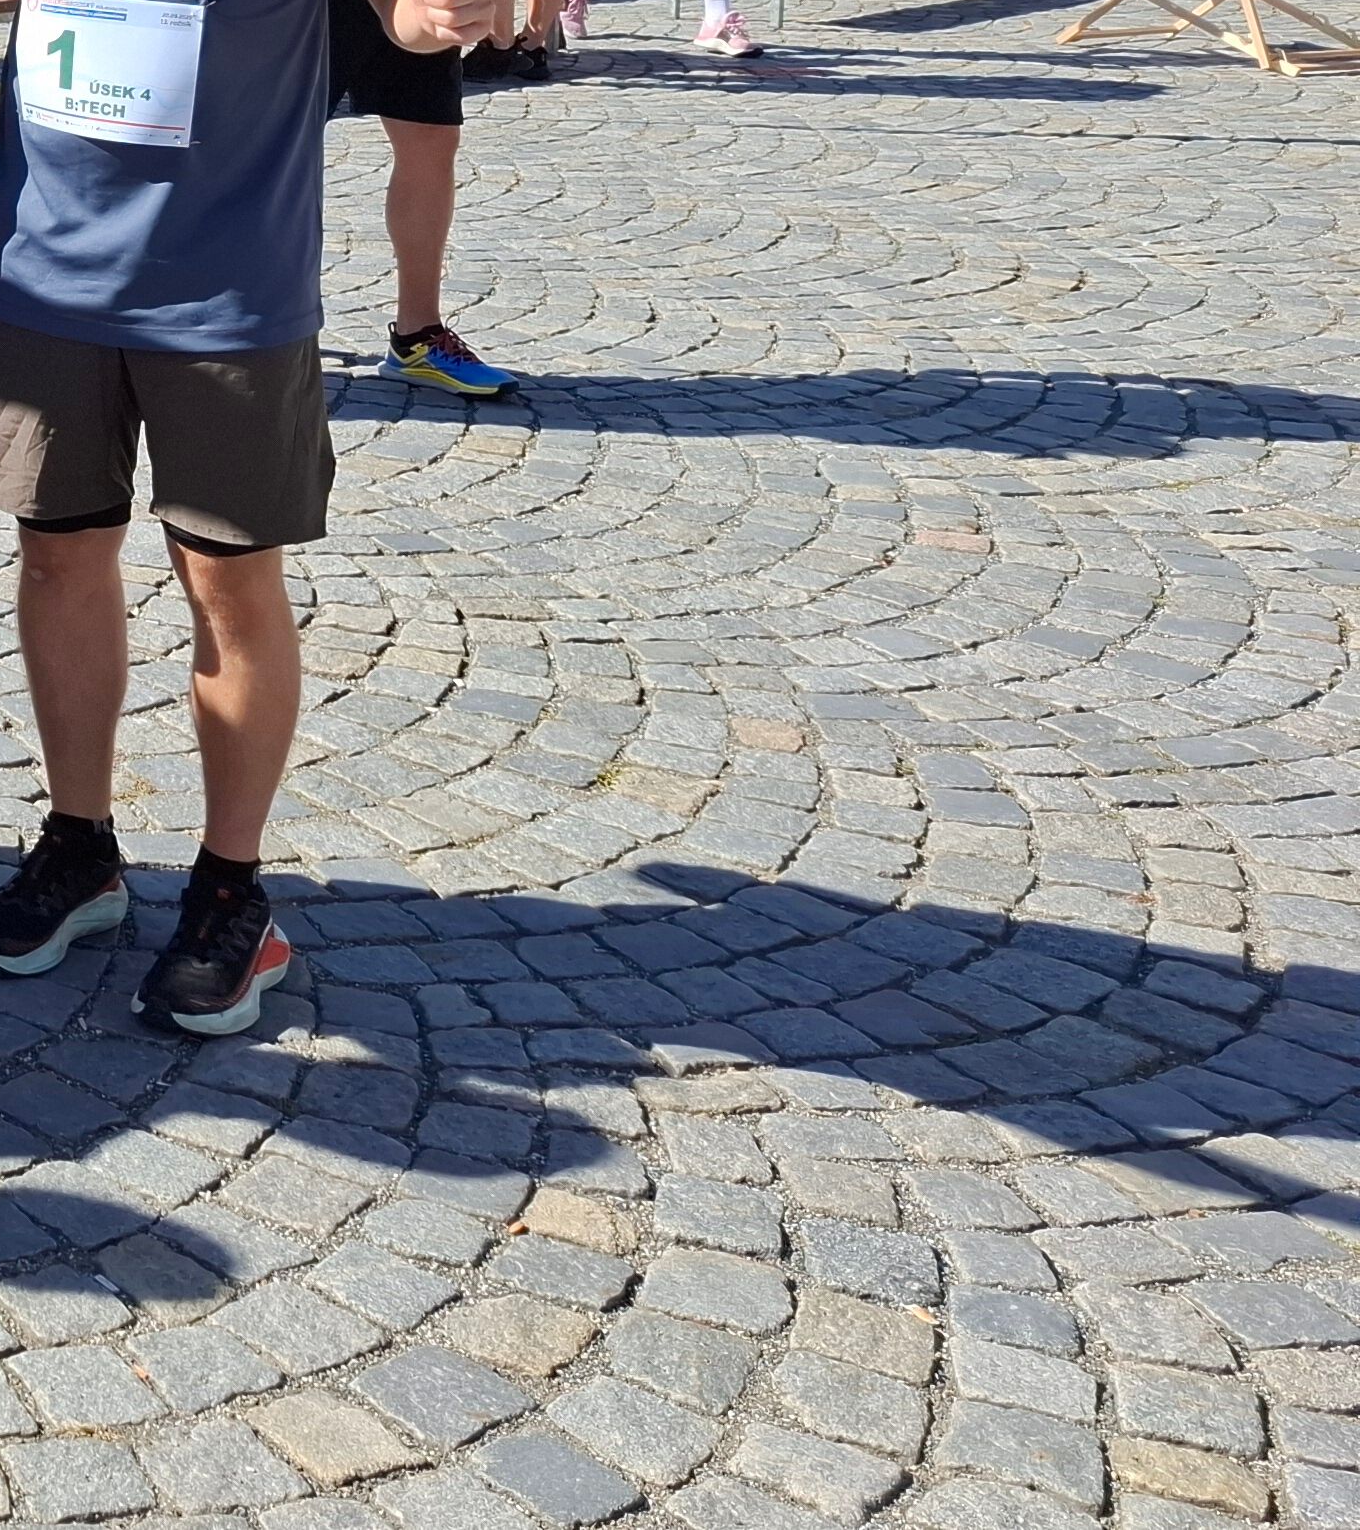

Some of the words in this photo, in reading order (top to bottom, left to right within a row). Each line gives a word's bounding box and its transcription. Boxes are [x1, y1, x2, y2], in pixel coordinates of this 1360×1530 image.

[47, 29, 76, 90] 1
[89, 80, 136, 99] ÚSEK
[140, 88, 152, 101] 4
[65, 96, 126, 118] B:TECH
